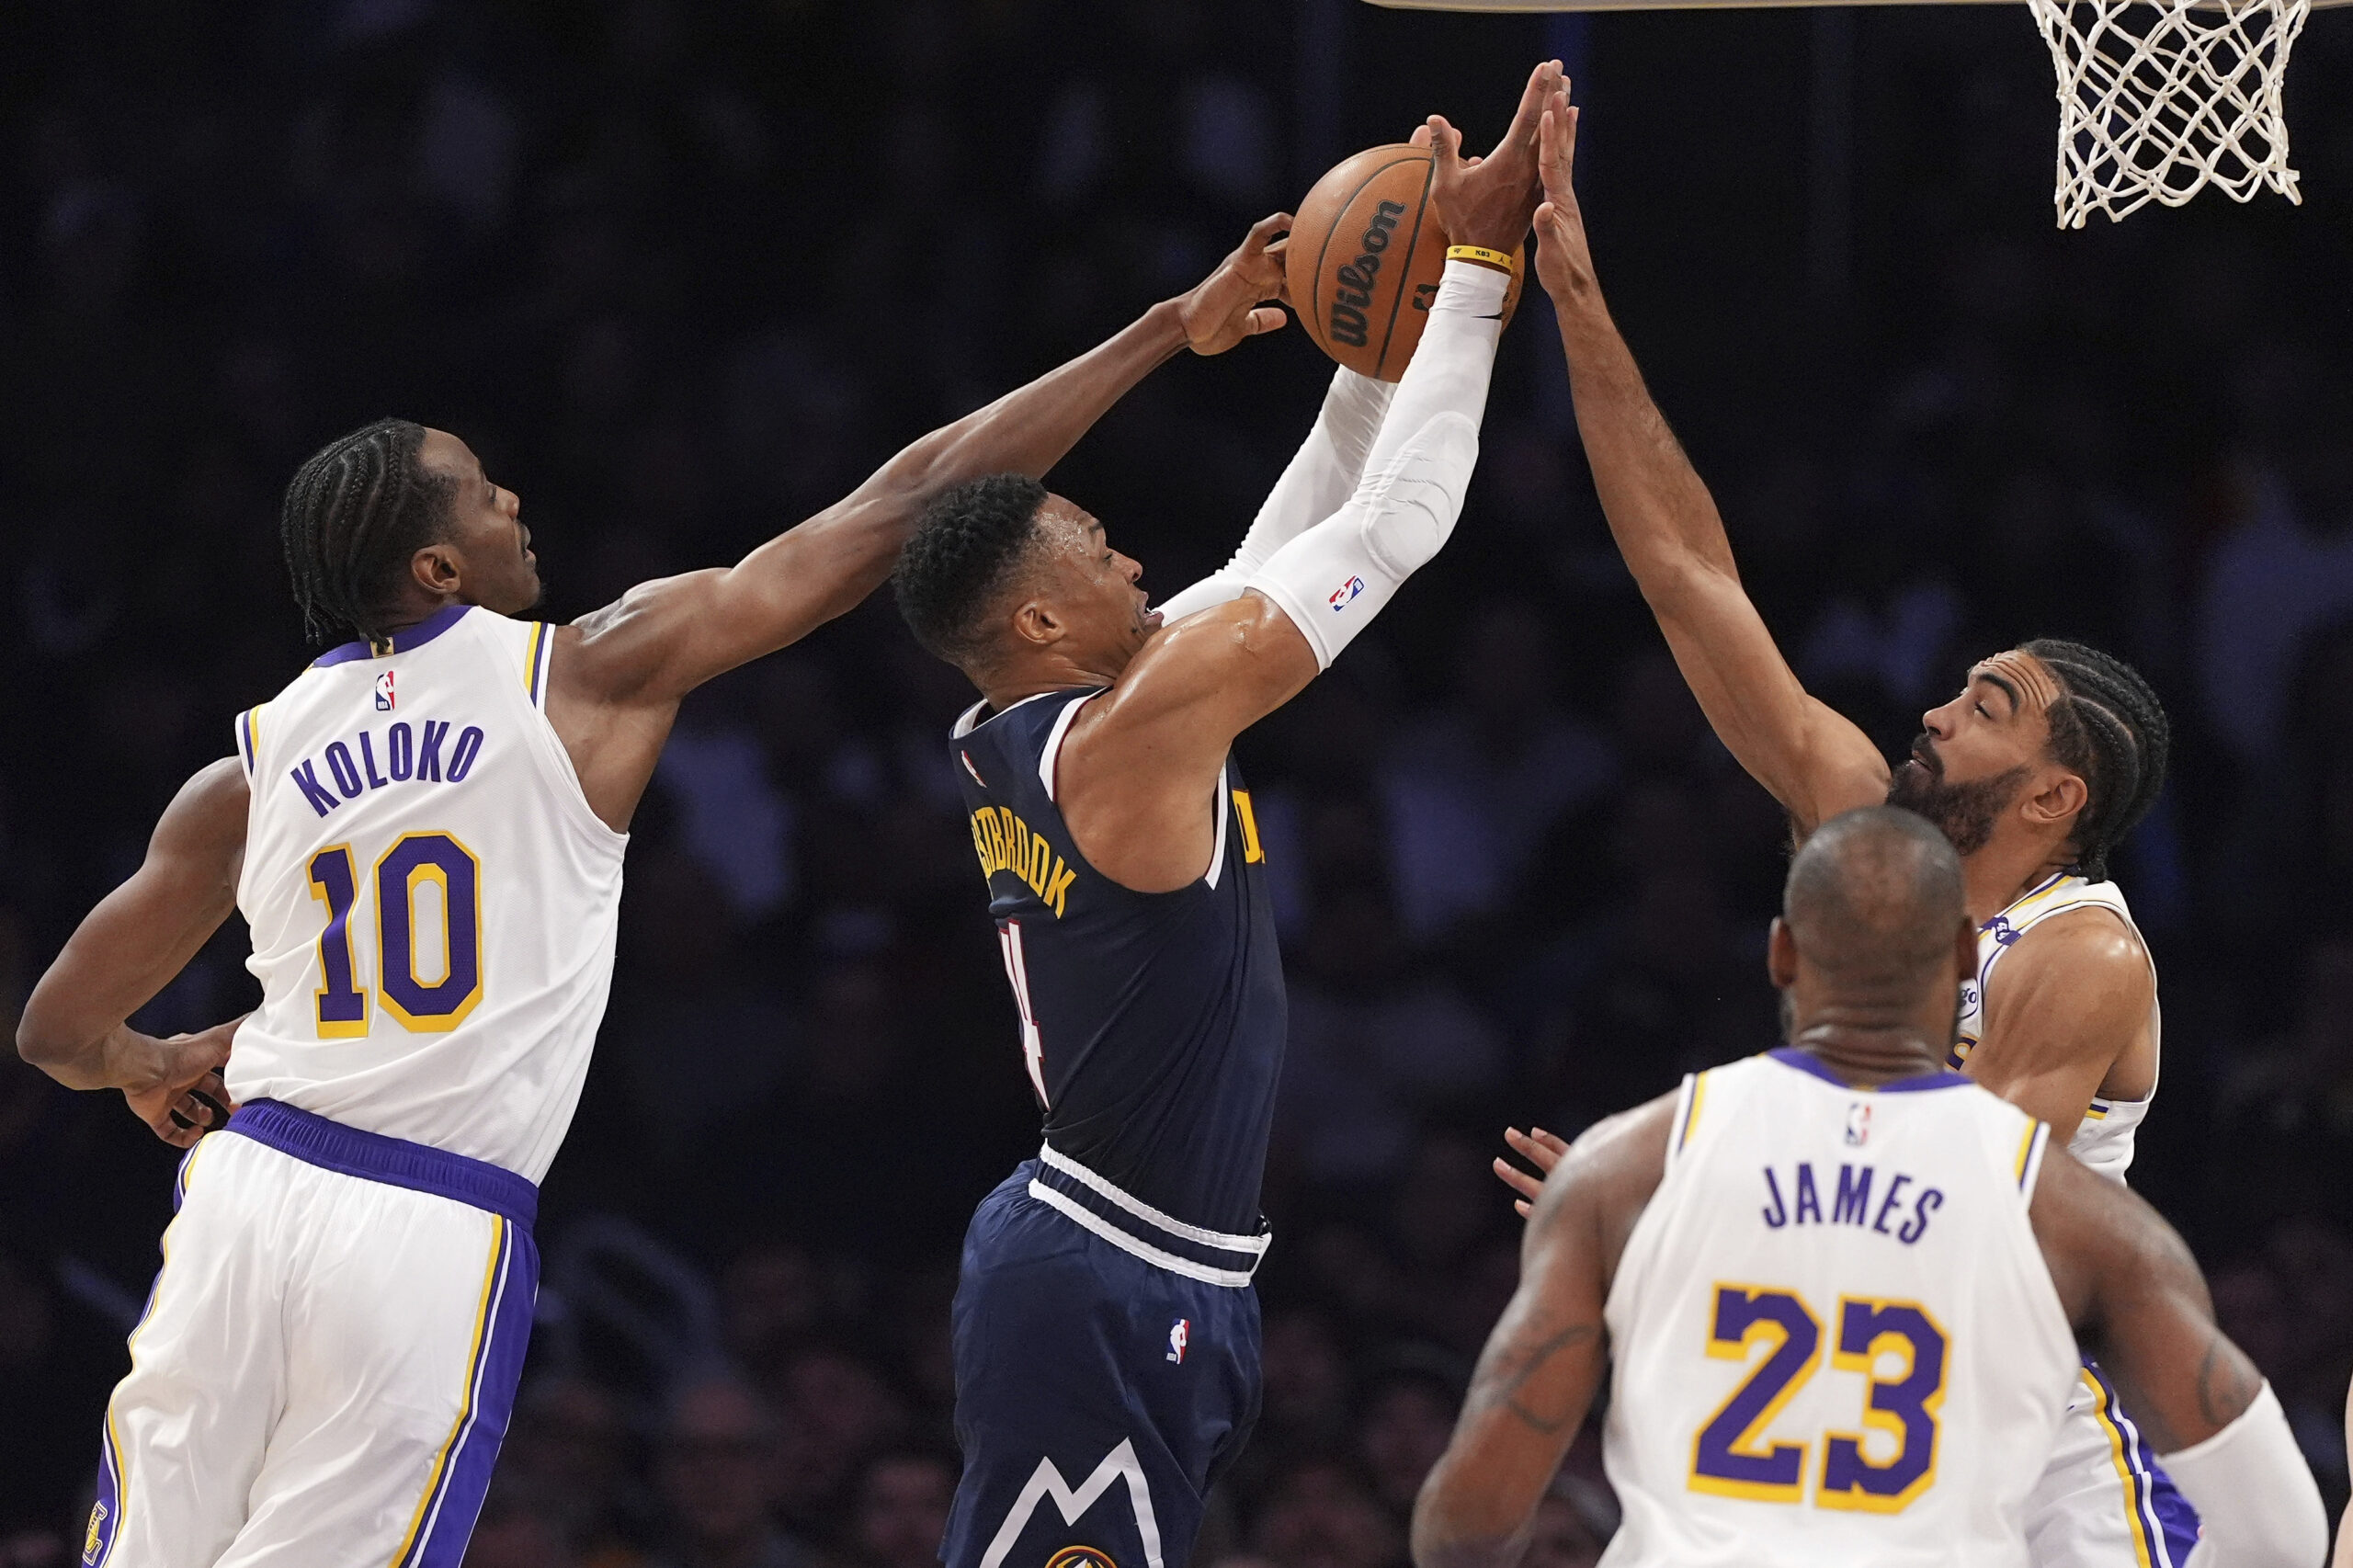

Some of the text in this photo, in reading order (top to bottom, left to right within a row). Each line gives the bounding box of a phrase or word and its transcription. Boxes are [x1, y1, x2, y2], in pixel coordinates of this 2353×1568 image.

[1331, 199, 1406, 347] Wilson
[290, 720, 483, 818] KOLOKO
[972, 806, 1076, 919] STBROOK
[305, 830, 483, 1039] 10
[1762, 1162, 1945, 1244] JAMES
[1686, 1280, 1951, 1516] 23
